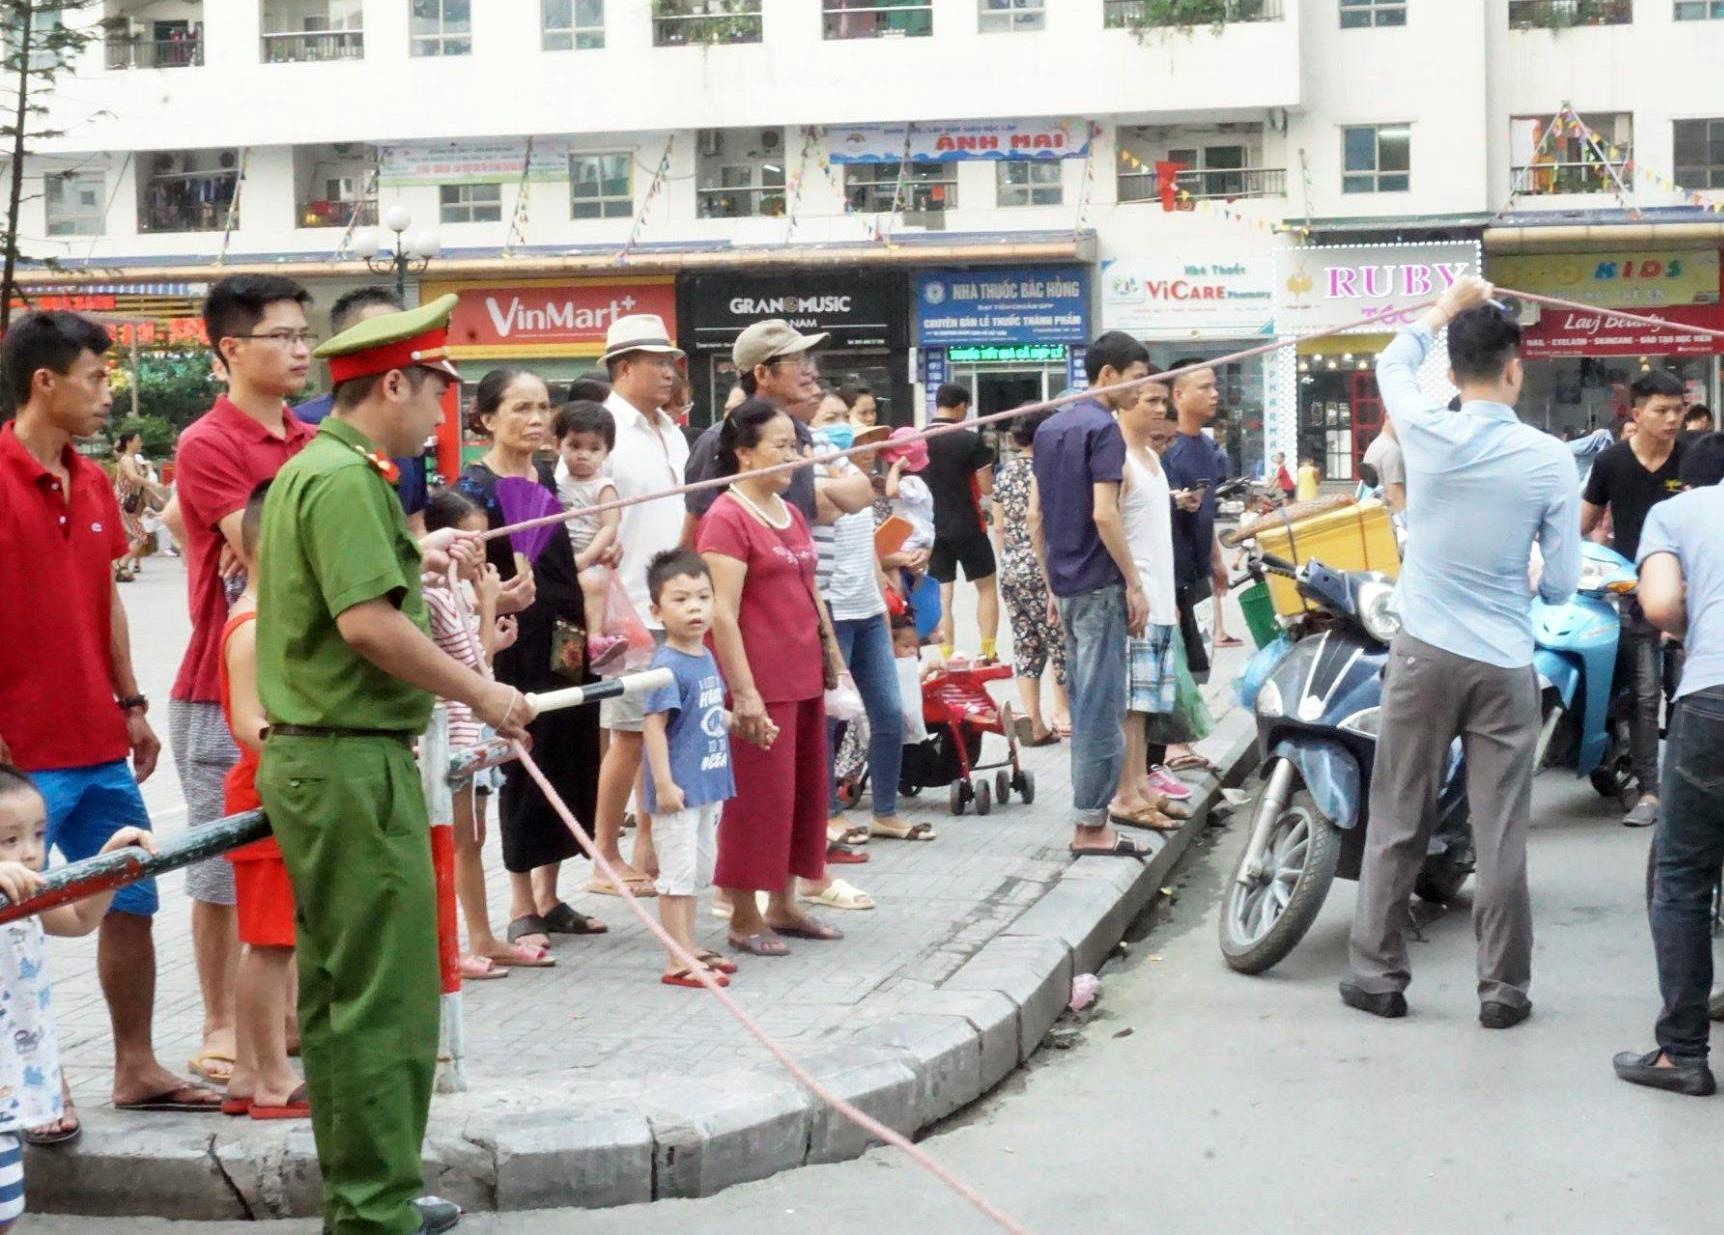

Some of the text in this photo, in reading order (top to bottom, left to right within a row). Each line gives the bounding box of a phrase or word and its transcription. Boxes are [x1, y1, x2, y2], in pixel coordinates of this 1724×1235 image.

[1010, 133, 1065, 149] MAI
[1594, 259, 1683, 279] KIDS
[980, 277, 1018, 299] THUỐC
[1325, 262, 1470, 299] RUBY
